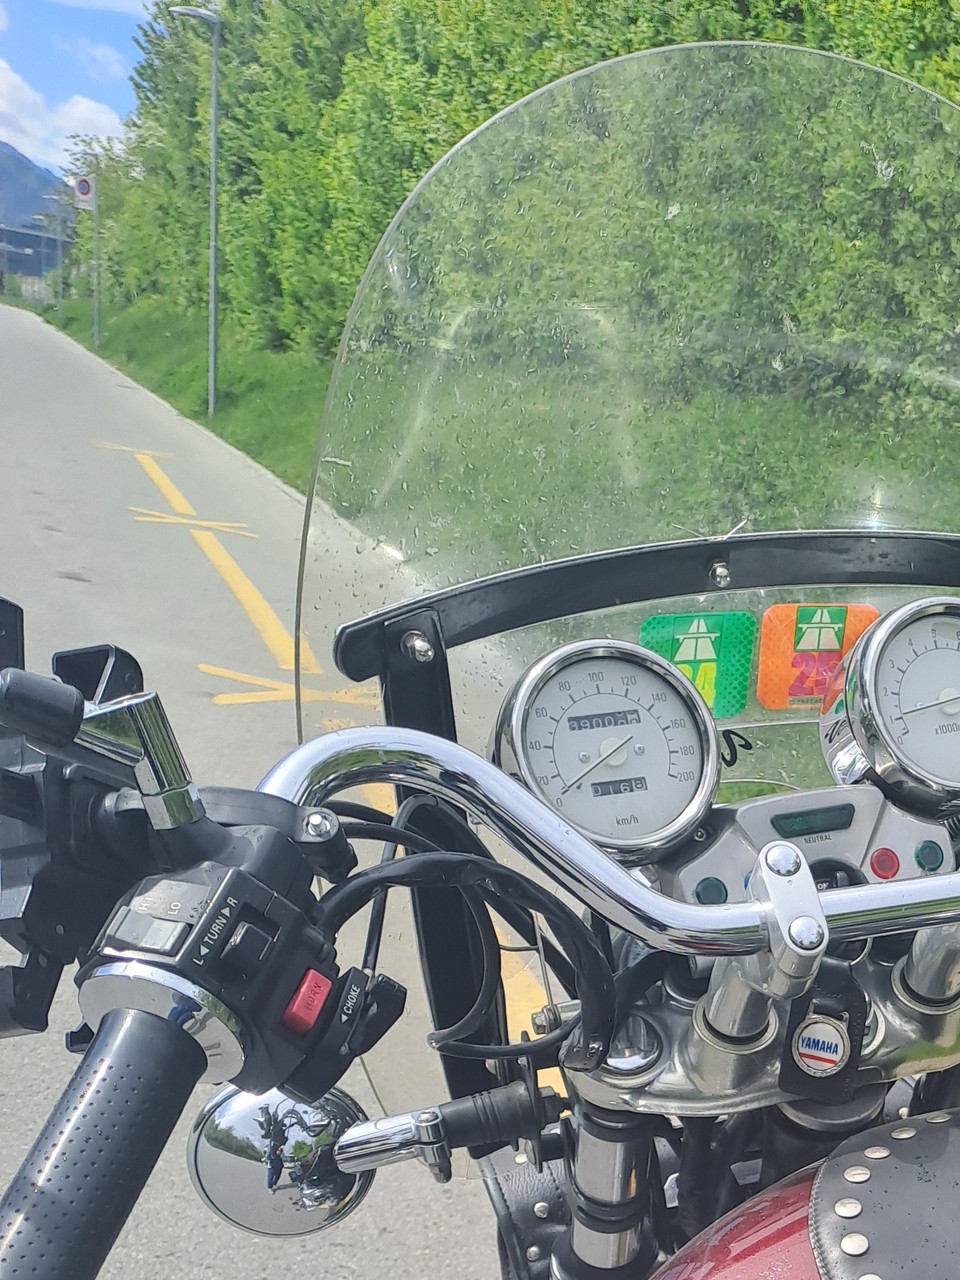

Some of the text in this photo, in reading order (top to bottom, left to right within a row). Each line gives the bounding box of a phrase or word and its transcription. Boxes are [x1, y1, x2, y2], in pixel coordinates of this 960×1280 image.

[889, 659, 895, 669] 3
[588, 672, 604, 682] 100
[620, 675, 637, 686] 120
[558, 680, 571, 692] 80
[651, 693, 667, 703] 140
[535, 707, 548, 718] 60
[670, 718, 686, 729] 160
[528, 740, 542, 751] 40
[679, 745, 695, 756] 180
[677, 770, 695, 782] 200
[556, 797, 563, 808] 0
[616, 814, 639, 826] km/h
[803, 834, 832, 844] NEUTRAL
[817, 881, 829, 890] ON
[140, 897, 153, 911] HI
[168, 902, 181, 915] LO
[192, 896, 239, 966] L TURN R
[343, 983, 361, 1014] CHOKE
[800, 1034, 839, 1056] YAMAHA
